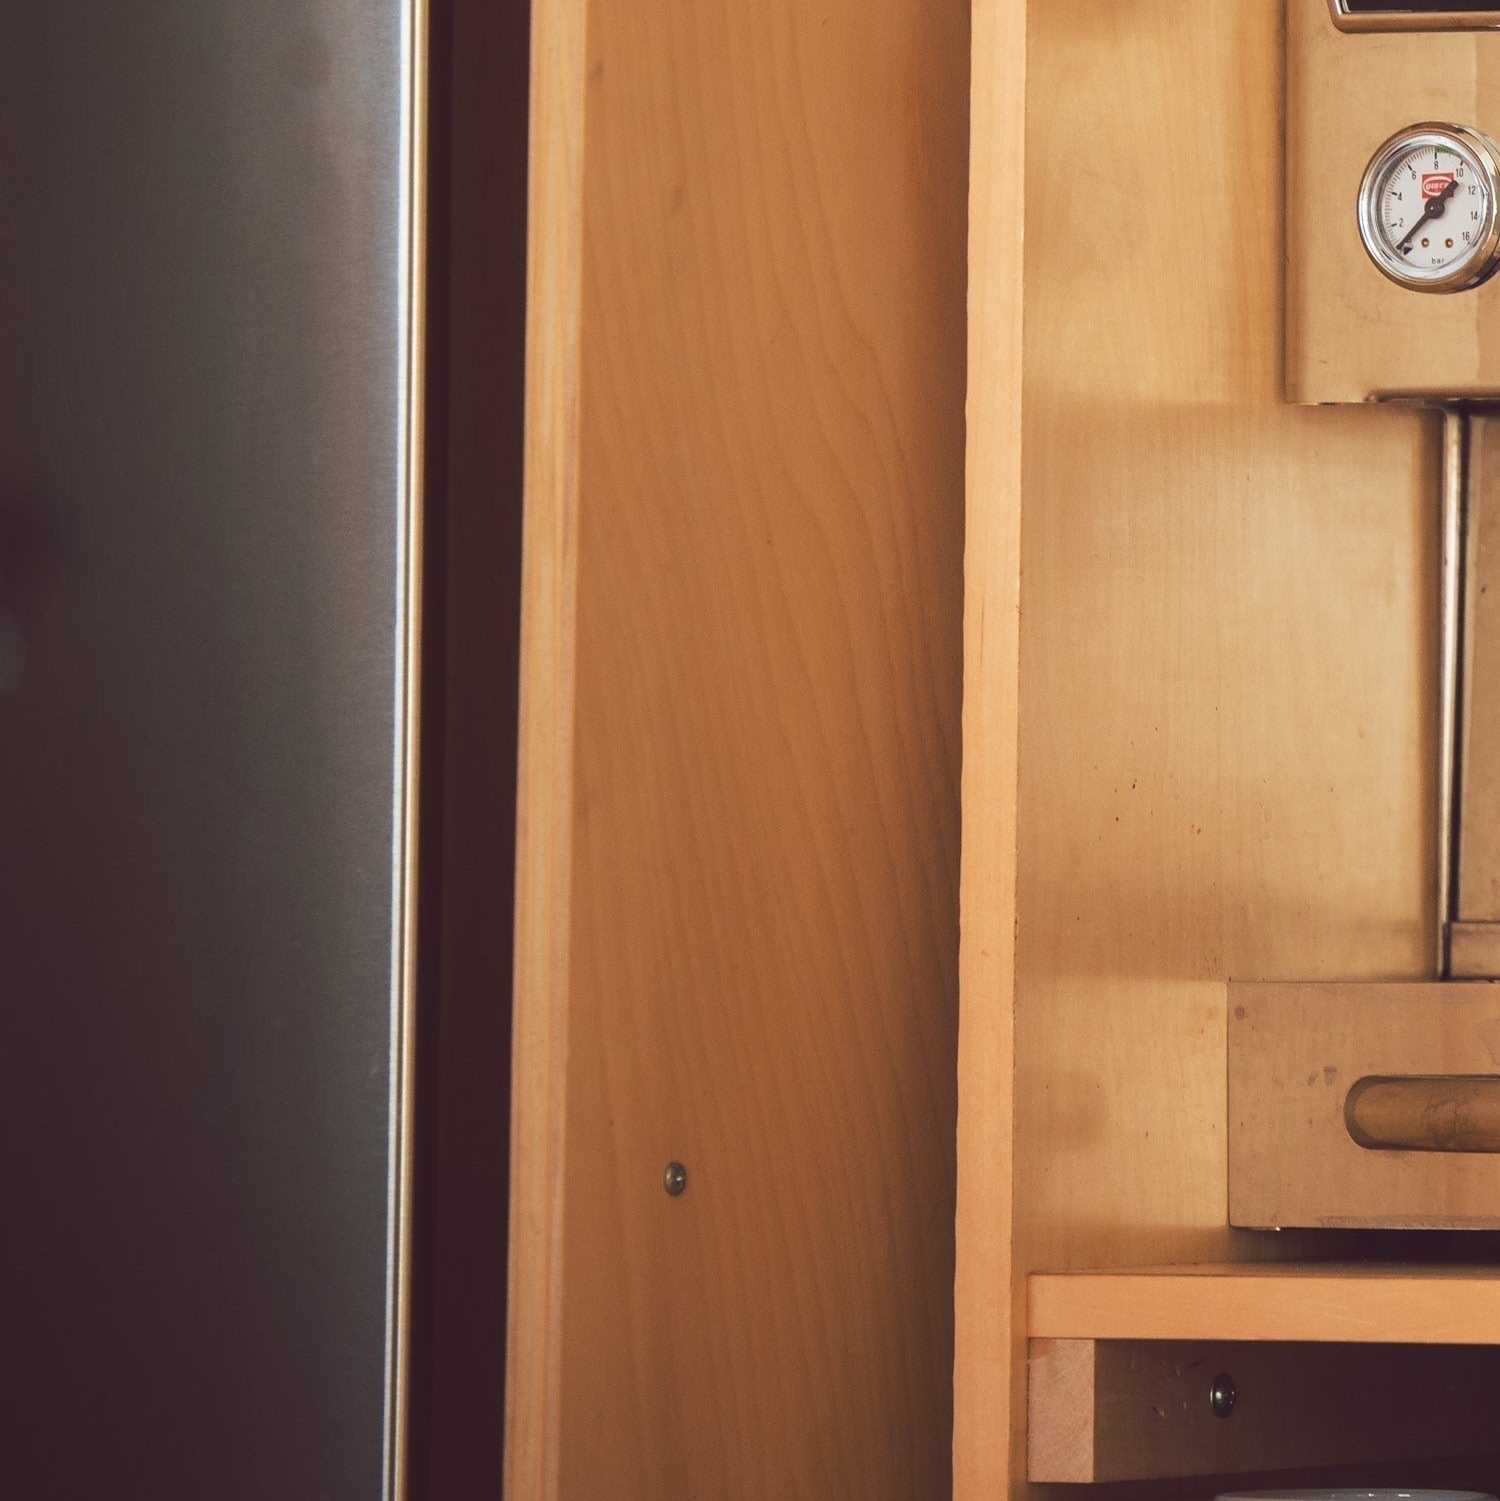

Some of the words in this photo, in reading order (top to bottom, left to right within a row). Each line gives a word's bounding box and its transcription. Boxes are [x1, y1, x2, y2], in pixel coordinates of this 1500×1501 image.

[1434, 160, 1439, 170] 8
[1411, 171, 1417, 180] 6
[1456, 168, 1464, 178] 10
[1468, 185, 1476, 196] 12
[1397, 192, 1403, 201] 4
[1470, 211, 1478, 220] 14
[1399, 218, 1404, 228] 2
[1462, 231, 1470, 241] 16
[1431, 257, 1445, 265] bar
